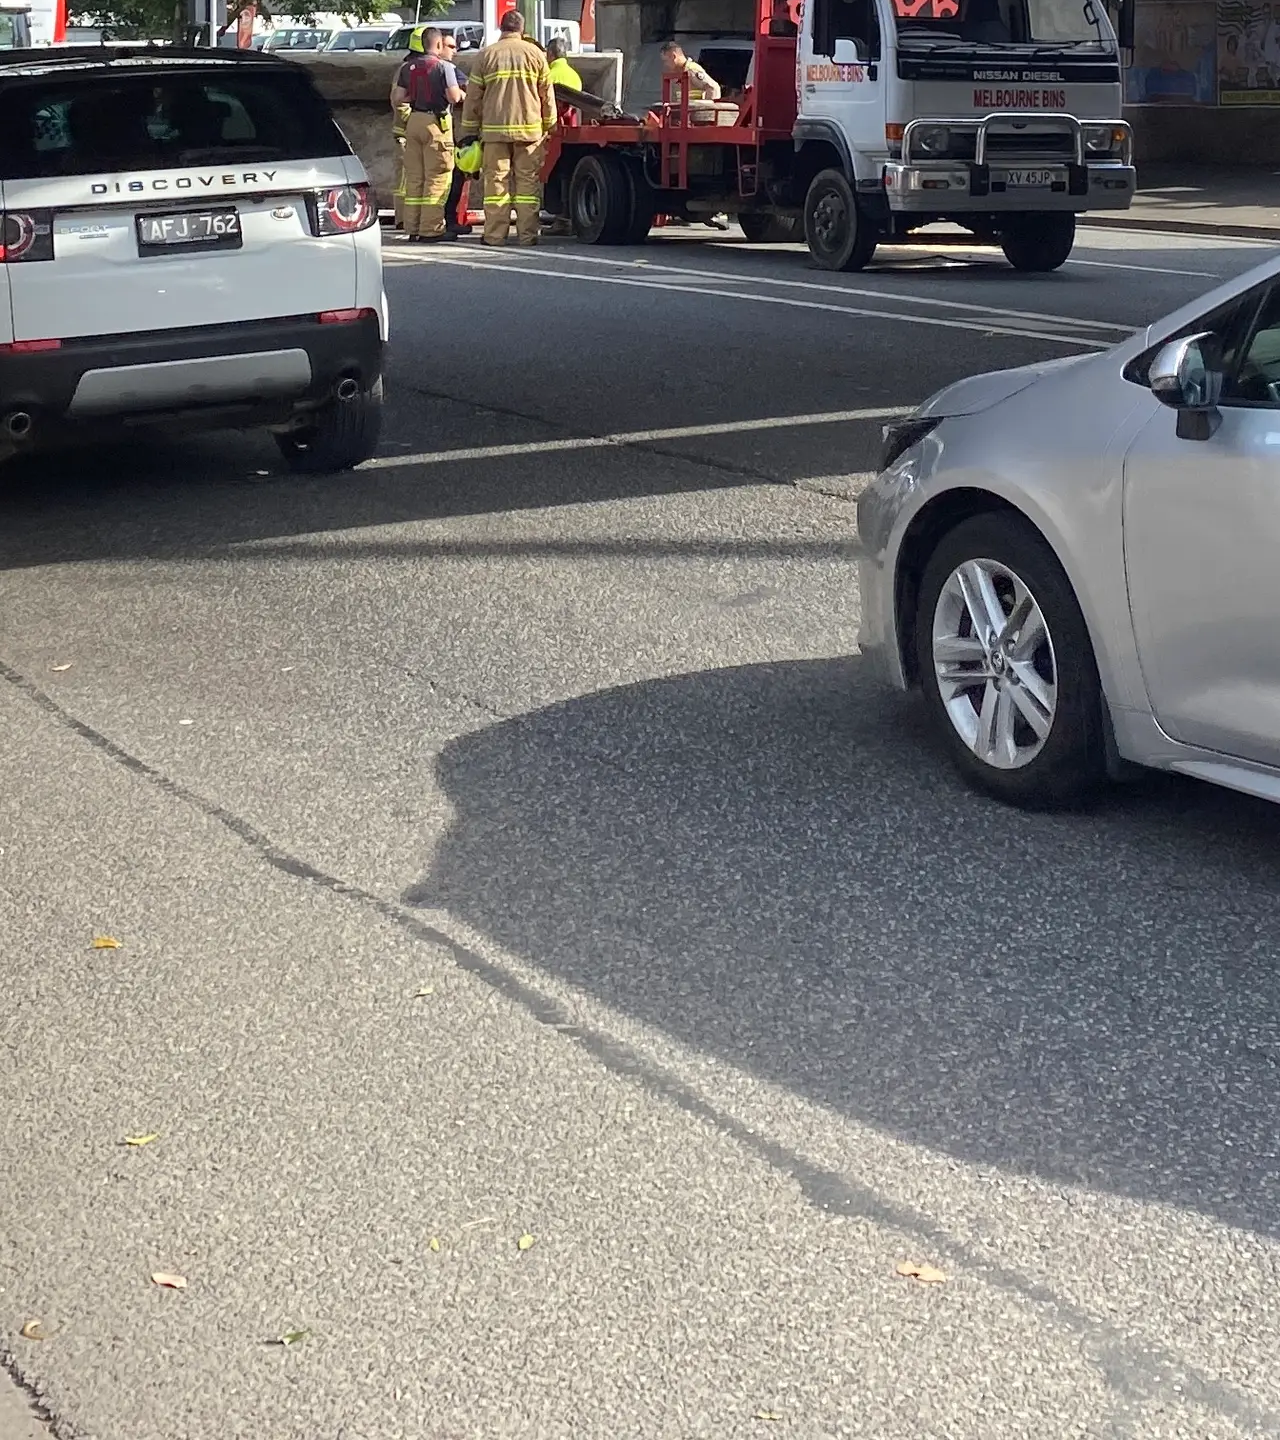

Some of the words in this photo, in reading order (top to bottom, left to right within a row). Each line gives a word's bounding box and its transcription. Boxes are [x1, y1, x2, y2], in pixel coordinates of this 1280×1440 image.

[806, 64, 845, 82] MELBOURNE
[973, 70, 1019, 80] NISSAN
[1022, 71, 1066, 81] DIESEL
[973, 89, 1040, 108] MELBOURNE
[1042, 90, 1066, 108] BINS
[91, 170, 278, 195] DISCOVERY
